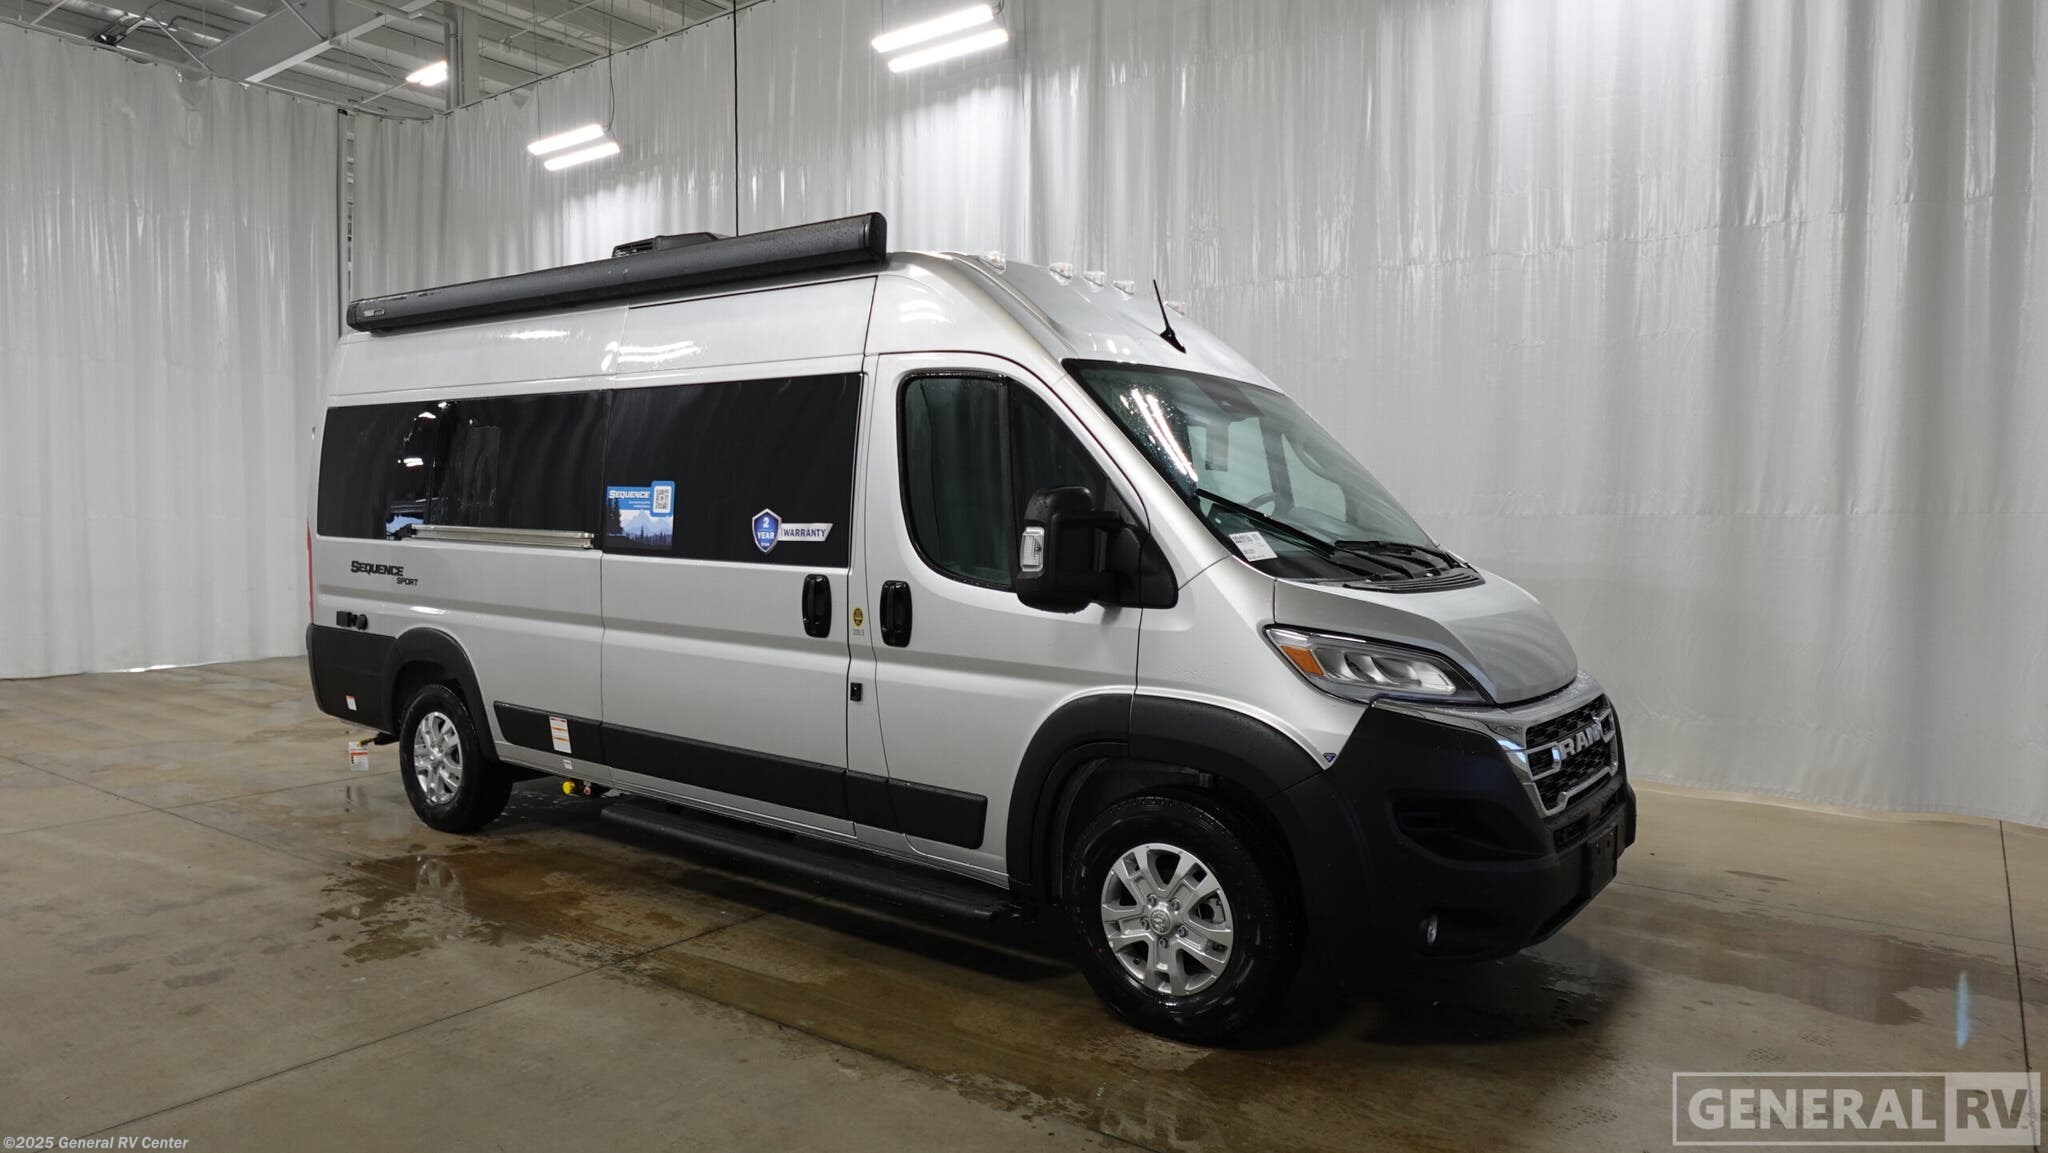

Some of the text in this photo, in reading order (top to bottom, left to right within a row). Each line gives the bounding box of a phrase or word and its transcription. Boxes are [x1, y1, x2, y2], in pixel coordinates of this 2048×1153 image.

[609, 490, 651, 499] SEQUENCE
[763, 517, 769, 529] 2
[757, 532, 775, 540] YEAR
[783, 528, 826, 537] WARRANTY
[350, 560, 404, 576] SEQUENCE
[396, 577, 418, 586] SPORT
[1559, 722, 1601, 761] RAM
